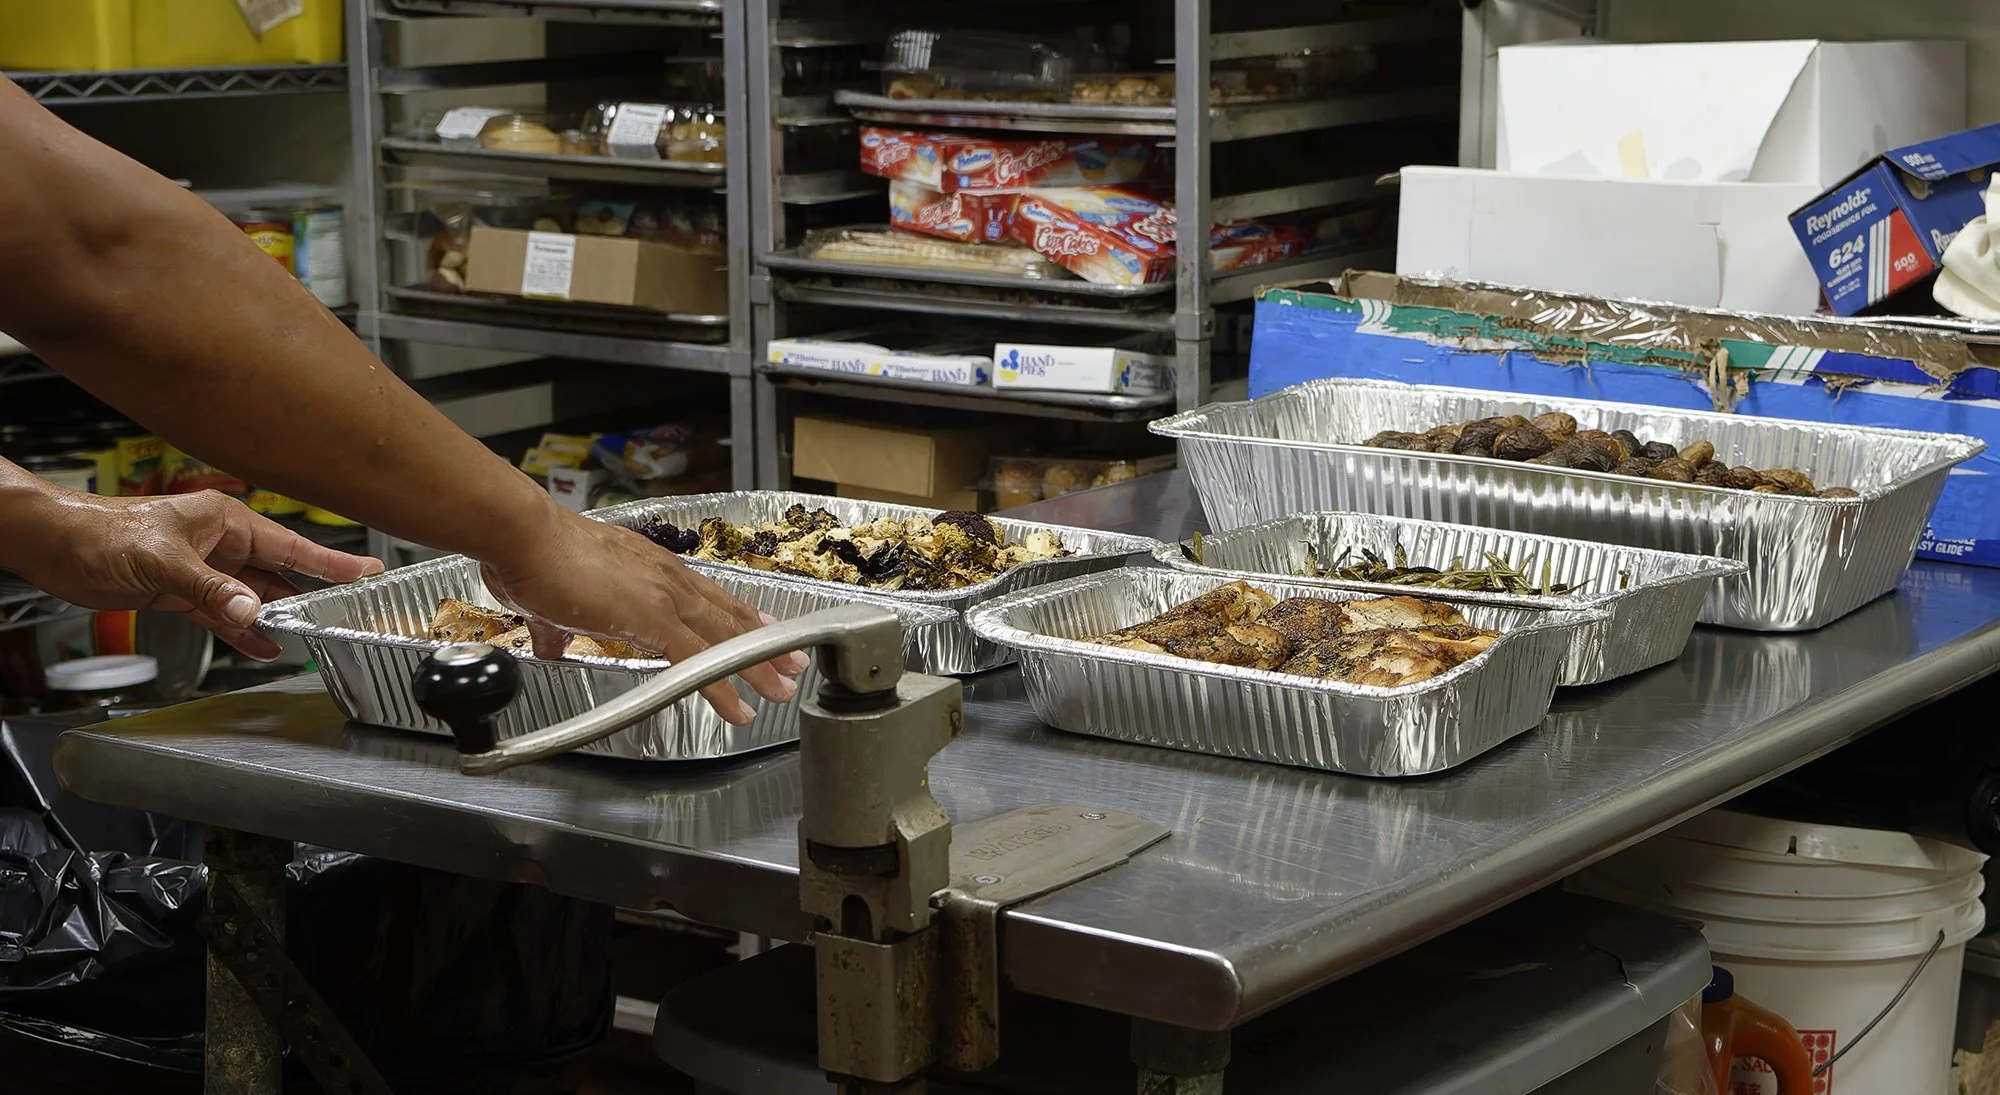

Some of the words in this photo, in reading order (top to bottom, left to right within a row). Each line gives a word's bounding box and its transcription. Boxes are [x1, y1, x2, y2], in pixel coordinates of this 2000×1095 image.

[1806, 188, 1870, 235] Reynolds
[1034, 222, 1100, 256] CupCakes
[1828, 234, 1865, 269] 624
[1020, 354, 1056, 367] HAND
[1935, 542, 1964, 556] GLIDE
